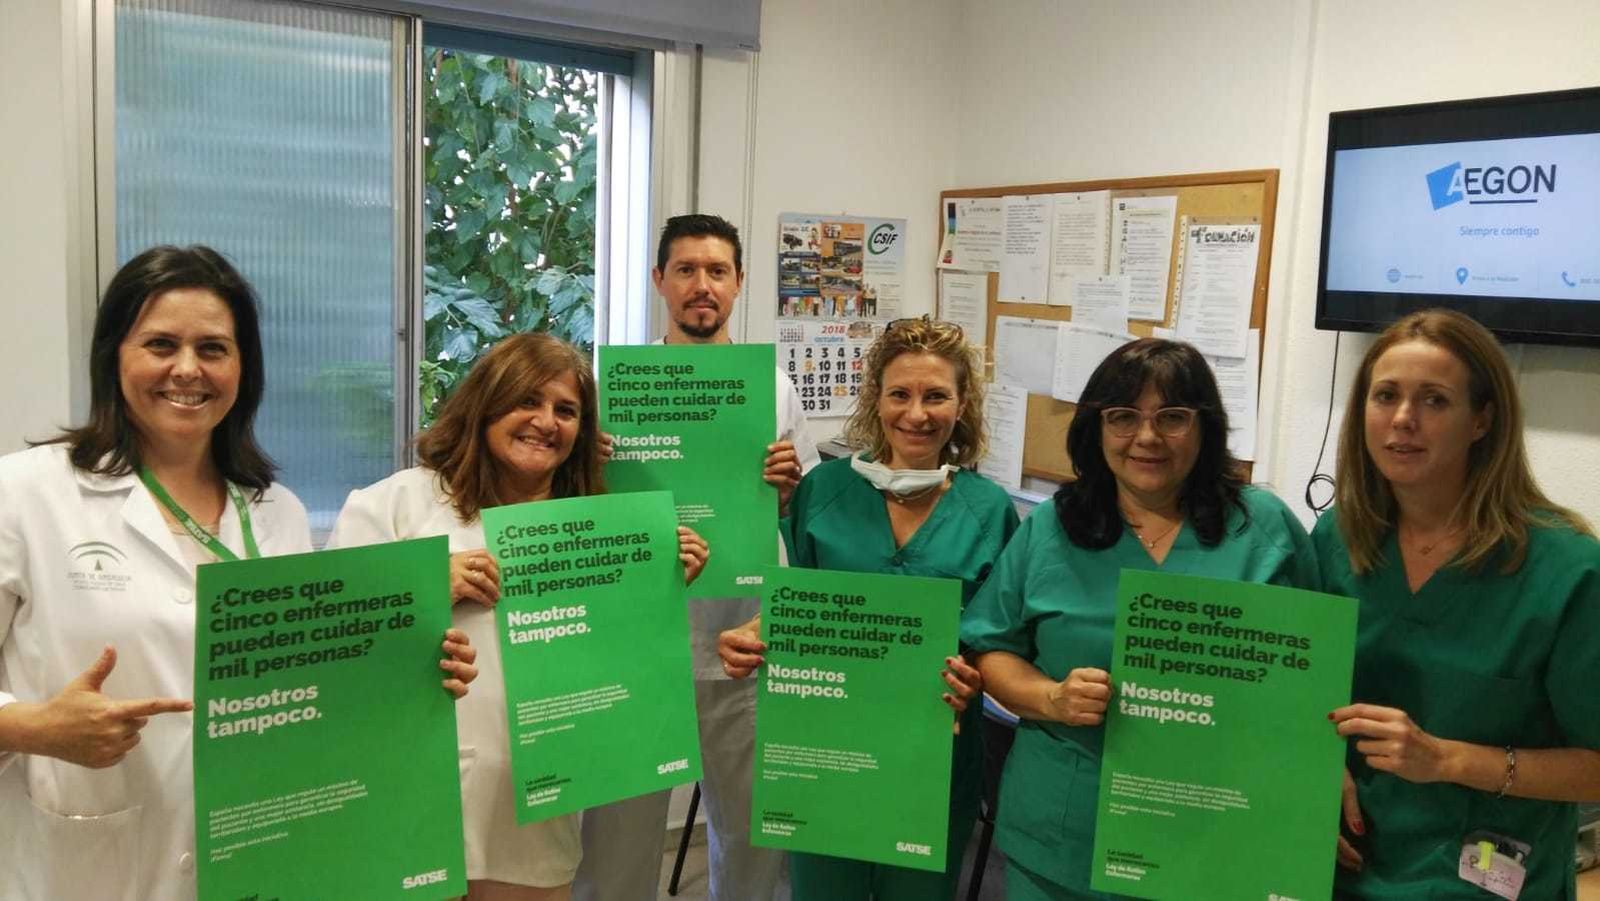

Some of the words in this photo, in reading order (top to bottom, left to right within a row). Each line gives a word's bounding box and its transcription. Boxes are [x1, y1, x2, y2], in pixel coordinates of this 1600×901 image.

[1446, 164, 1557, 196] AEGON
[874, 232, 898, 244] CSIF
[1460, 226, 1499, 237] Siempre
[1501, 227, 1540, 238] contigo
[821, 326, 846, 334] 2018
[790, 348, 795, 358] 1
[805, 348, 812, 358] 2
[821, 348, 828, 358] 3
[837, 347, 845, 357] 4
[854, 347, 861, 358] 5
[608, 363, 660, 378] ¿Crees
[664, 364, 694, 378] que
[788, 361, 796, 372] 8
[819, 360, 831, 370] 10
[836, 361, 846, 370] 11
[851, 360, 863, 370] 12
[608, 379, 650, 391] cinco
[654, 378, 745, 391] enfermeras
[803, 374, 814, 384] 16
[819, 373, 830, 384] 17
[835, 373, 847, 384] 18
[608, 394, 669, 410] pueden
[672, 393, 723, 406] cuidar
[726, 392, 746, 405] de
[802, 387, 815, 397] 23
[817, 386, 831, 396] 24
[802, 400, 815, 410] 30
[819, 400, 830, 410] 31
[608, 410, 634, 423] mil
[637, 408, 717, 426] personas?
[610, 434, 681, 447] Nosotros
[497, 523, 558, 544] ¿Crees
[562, 519, 595, 535] que
[499, 542, 549, 559] cinco
[553, 532, 650, 553] enfermeras
[502, 558, 571, 582] pueden
[575, 553, 628, 569] cuidar
[631, 549, 652, 562] de
[504, 579, 534, 597] mil
[537, 568, 623, 597] personas?
[210, 585, 294, 614] ¿Crees
[300, 579, 345, 601] que
[771, 586, 829, 603] ¿Crees
[832, 593, 866, 608] que
[1129, 593, 1198, 613] ¿Crees
[1202, 602, 1243, 621] que
[209, 611, 278, 633] cinco
[283, 592, 414, 622] enfermeras
[507, 605, 587, 627] Nosotros
[770, 604, 816, 620] cinco
[820, 608, 923, 628] enfermeras
[209, 631, 305, 662] pueden
[310, 618, 384, 641] cuidar
[388, 612, 415, 629] de
[508, 622, 591, 644] tampoco.
[769, 622, 836, 638] pueden
[839, 627, 897, 643] cuidar
[899, 630, 923, 645] de
[1127, 612, 1183, 632] cinco
[1187, 621, 1311, 650] enfermeras
[208, 659, 249, 681] mil
[254, 639, 374, 678] personas?
[768, 639, 795, 652] mil
[799, 643, 889, 660] personas?
[1125, 633, 1204, 656] pueden
[1209, 643, 1278, 665] cuidar
[1281, 652, 1310, 671] de
[767, 663, 846, 683] Nosotros
[1123, 653, 1156, 670] mil
[1160, 657, 1268, 683] personas?
[767, 679, 848, 699] tampoco.
[1121, 681, 1214, 708] Nosotros
[208, 685, 318, 718] Nosotros
[1119, 699, 1216, 726] tampoco.
[207, 706, 323, 739] tampoco.
[657, 759, 689, 775] SATSE
[896, 841, 932, 856] SATSE
[403, 869, 448, 889] SATSE
